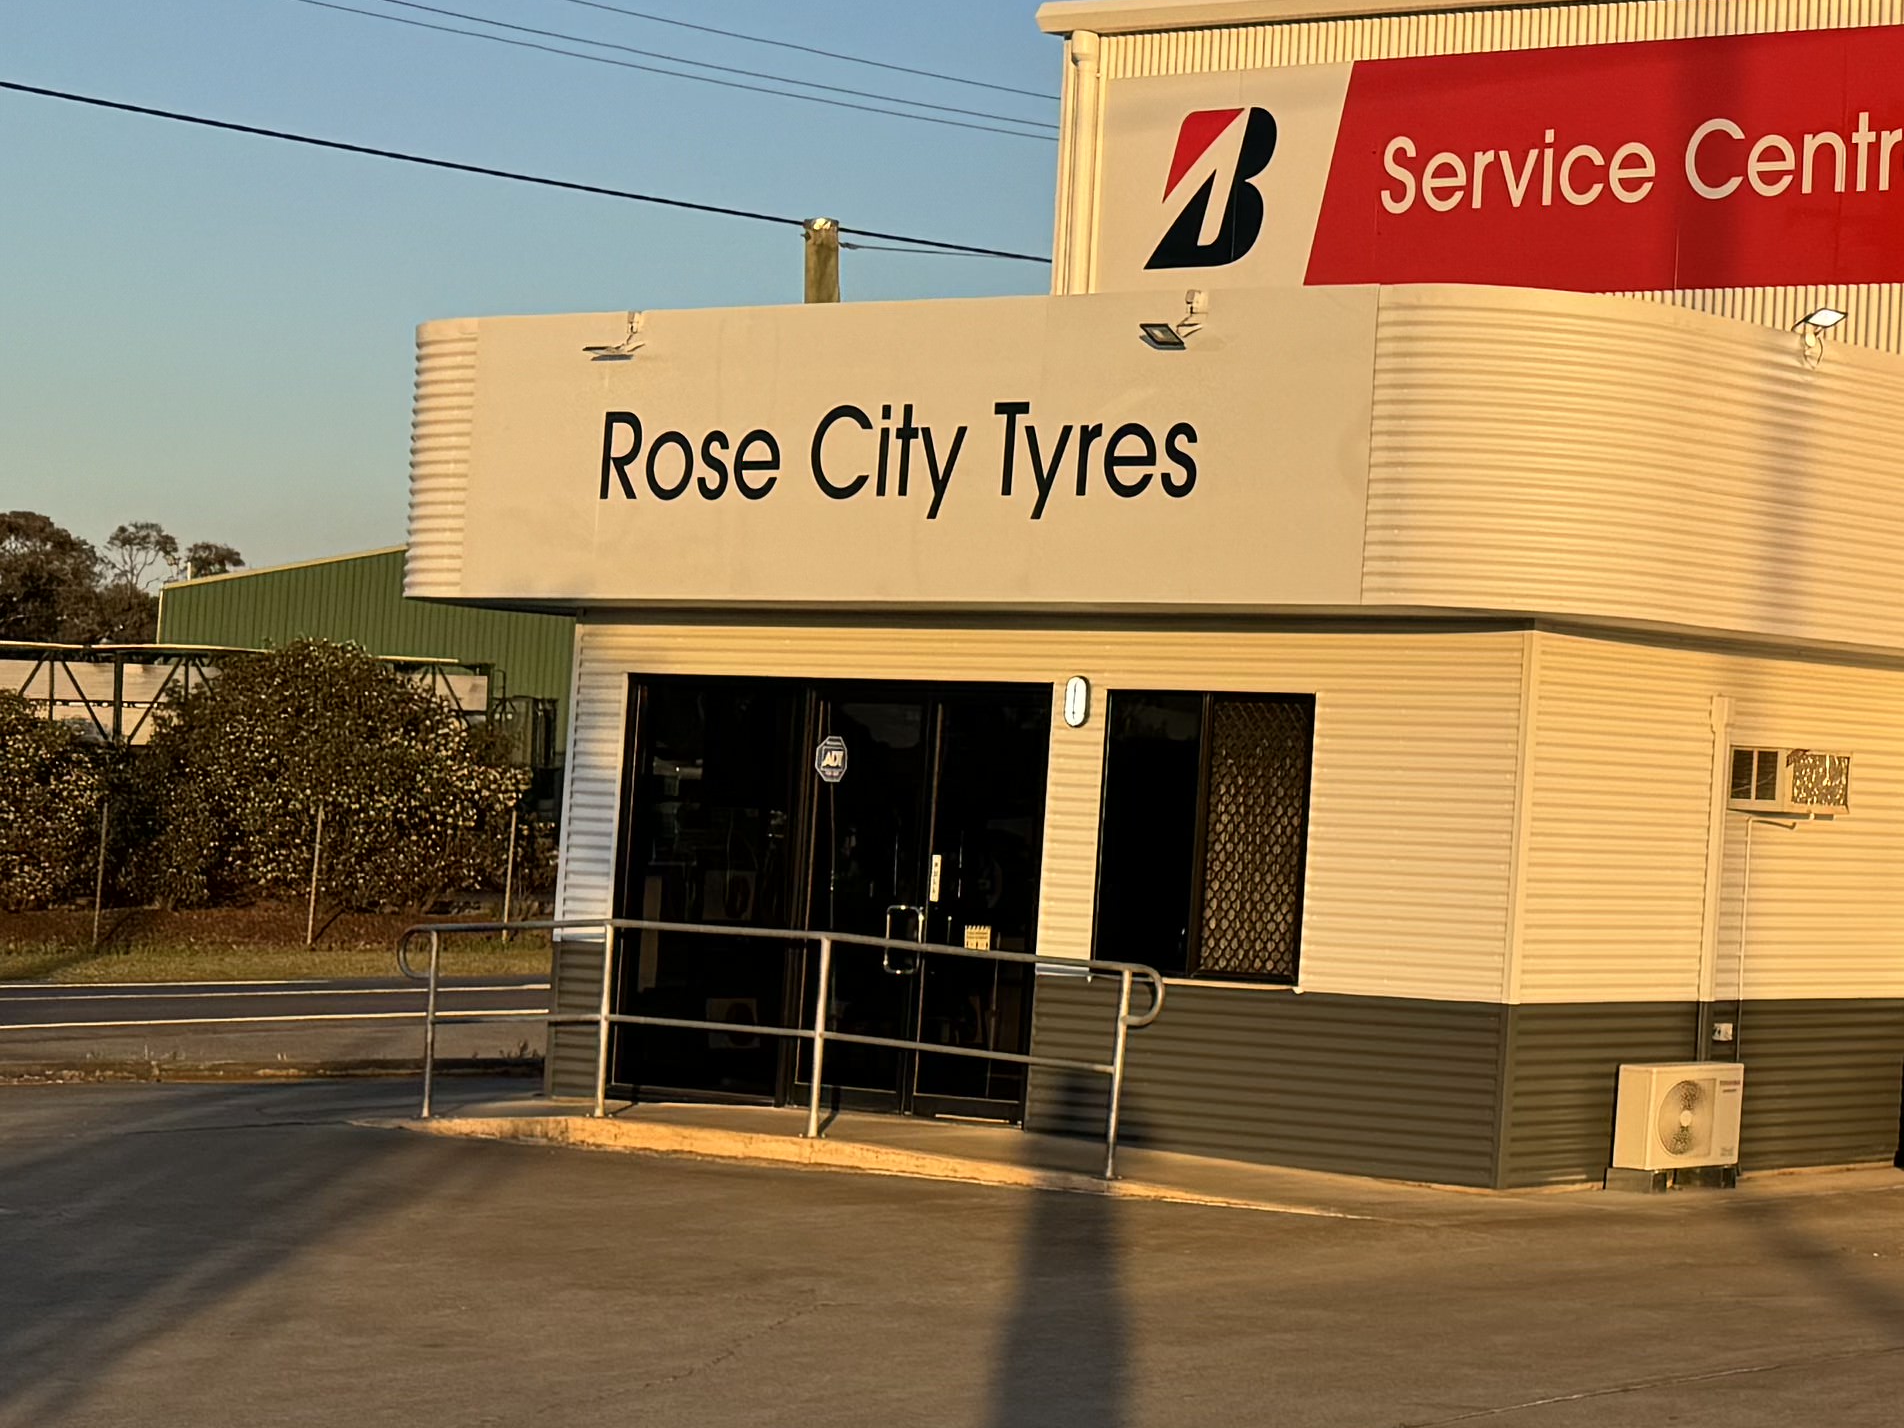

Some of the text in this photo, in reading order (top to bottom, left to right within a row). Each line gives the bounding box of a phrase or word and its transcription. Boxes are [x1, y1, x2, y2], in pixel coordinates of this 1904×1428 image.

[1144, 107, 1277, 269] B
[1381, 136, 1655, 213] Service
[600, 402, 1197, 519] Rose City Tyres
